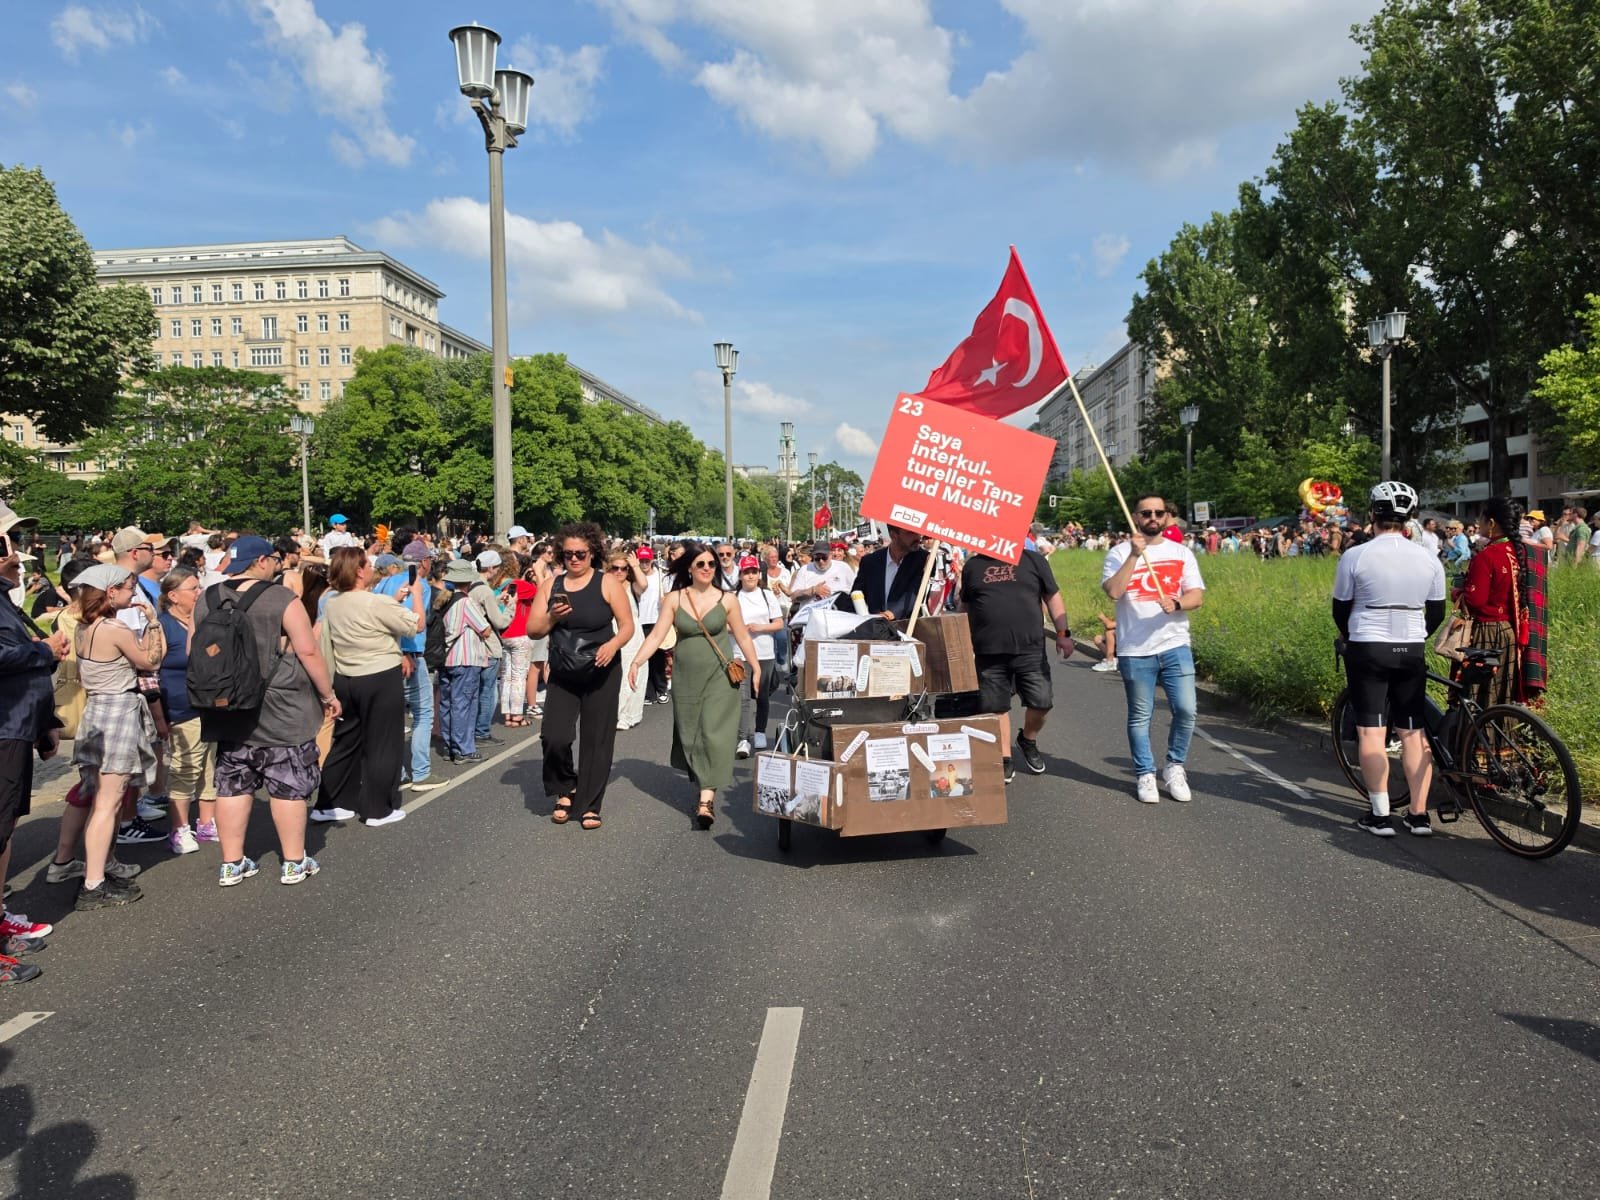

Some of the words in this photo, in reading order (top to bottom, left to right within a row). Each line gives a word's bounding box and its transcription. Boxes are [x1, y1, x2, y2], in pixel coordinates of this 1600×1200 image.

[898, 397, 924, 417] 23
[917, 424, 962, 451] Saya
[911, 440, 992, 477] interkul-
[901, 475, 939, 497] und
[942, 486, 1001, 518] Musik
[906, 457, 976, 490] tureller
[981, 479, 1024, 507] Tanz
[894, 510, 921, 524] rbb
